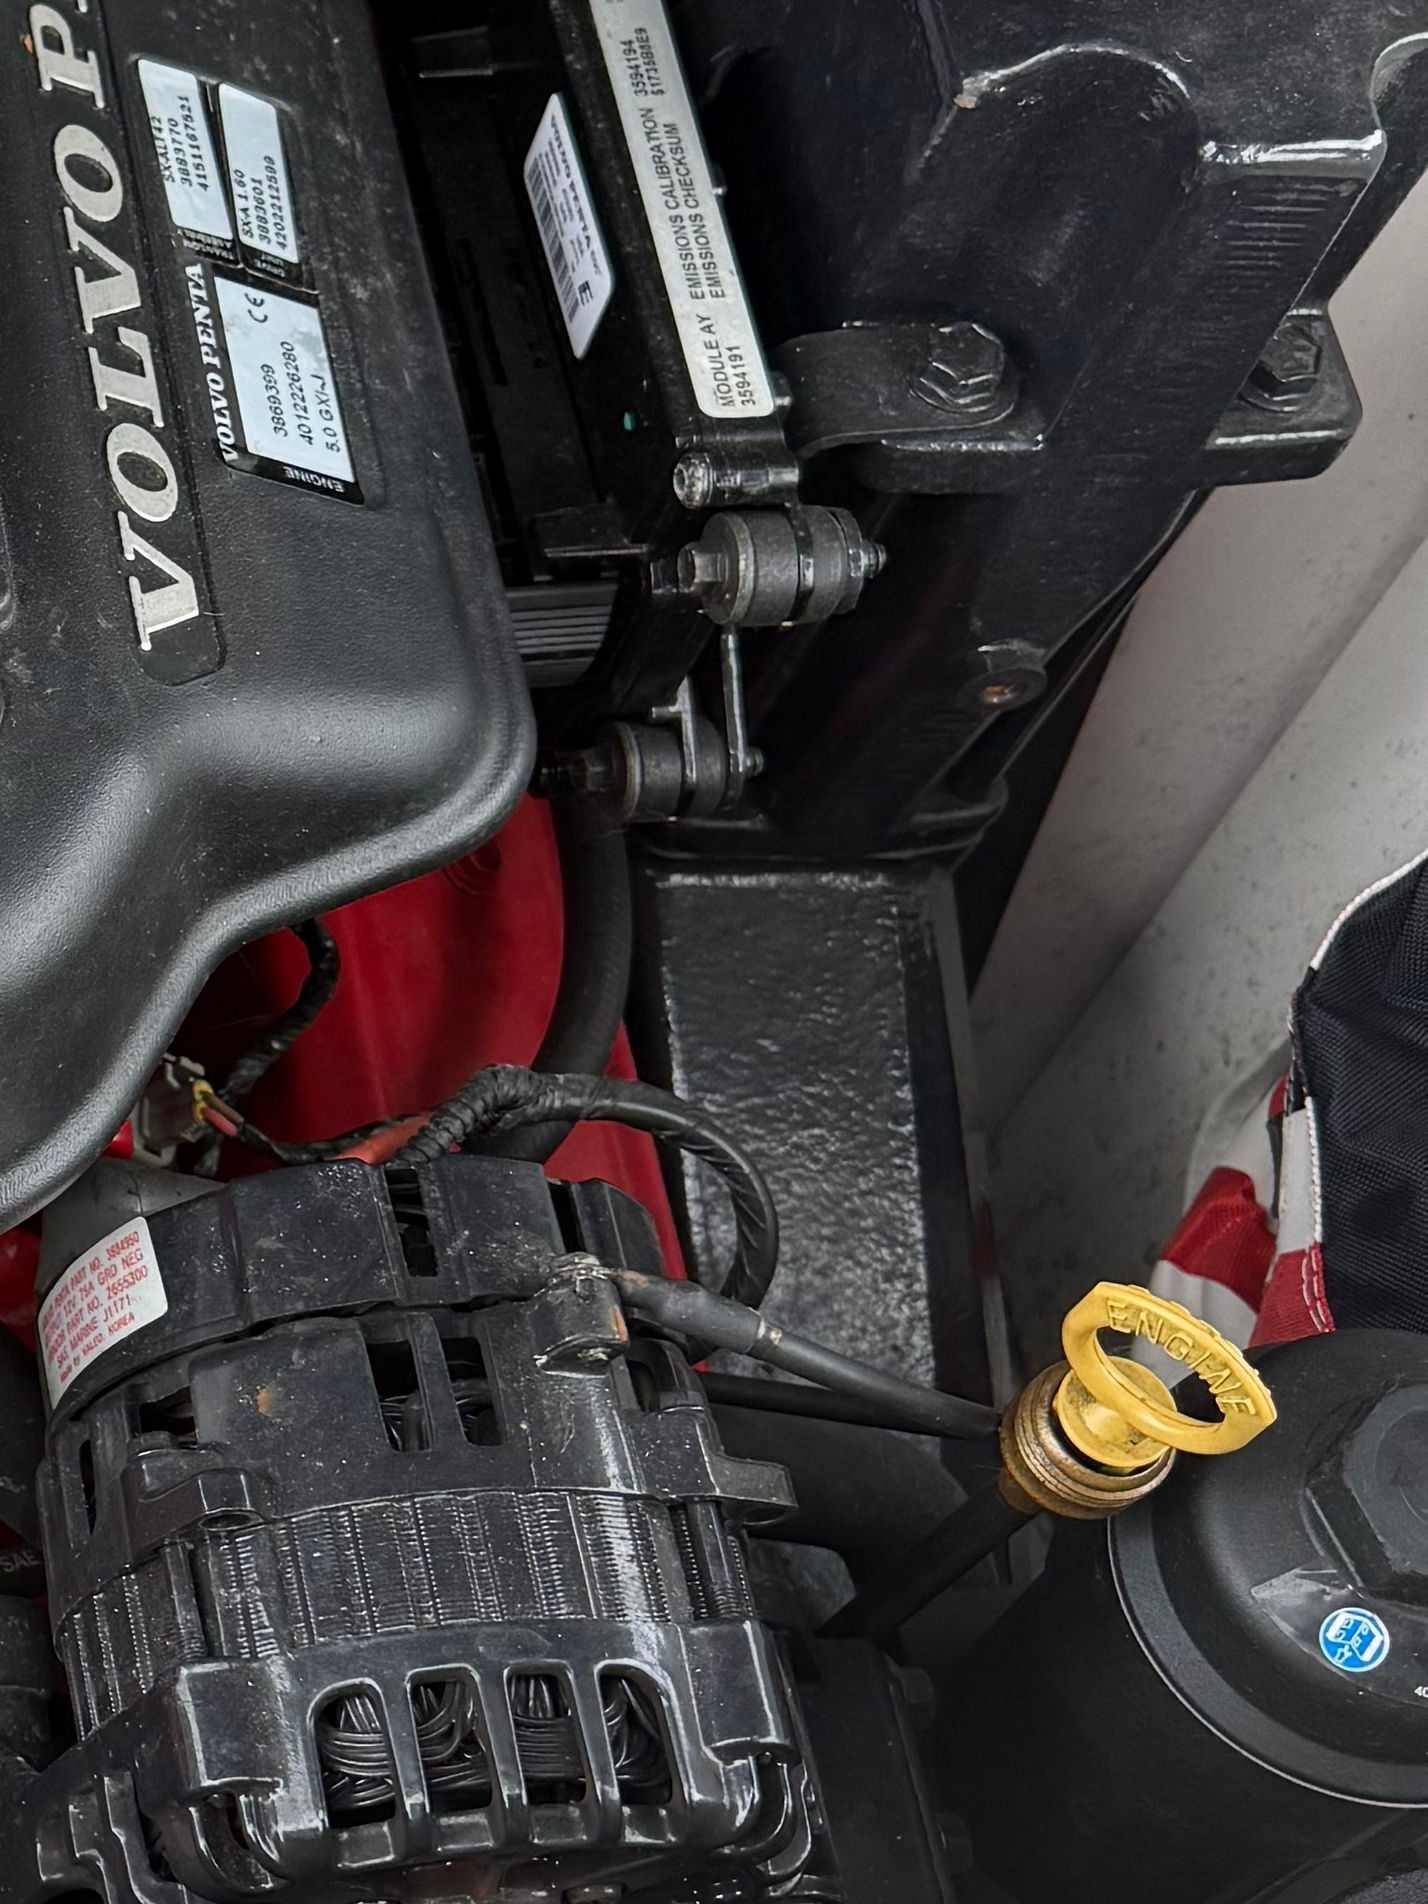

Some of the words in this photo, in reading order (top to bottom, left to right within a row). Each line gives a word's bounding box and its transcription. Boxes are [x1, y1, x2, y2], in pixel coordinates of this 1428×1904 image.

[637, 106, 681, 210] CALIBRATION
[661, 122, 701, 209] CHECKSUM
[667, 213, 705, 299] EMISSIONS
[686, 212, 726, 299] EMISSIONS
[184, 262, 223, 369] PENTA
[693, 312, 716, 334] AY
[51, 122, 202, 652] VOLVO
[259, 361, 288, 438] 3869399
[278, 339, 315, 446] 4012226280
[701, 337, 737, 406] MODULE
[724, 344, 757, 406] 3594191
[205, 365, 240, 461] VOLVO
[321, 425, 341, 453] 5.0
[282, 465, 345, 493] ENGINE
[121, 1249, 144, 1270] NEG
[103, 1293, 131, 1323] J1171
[107, 1312, 136, 1336] KOREA
[1106, 1299, 1259, 1416] ENGINE
